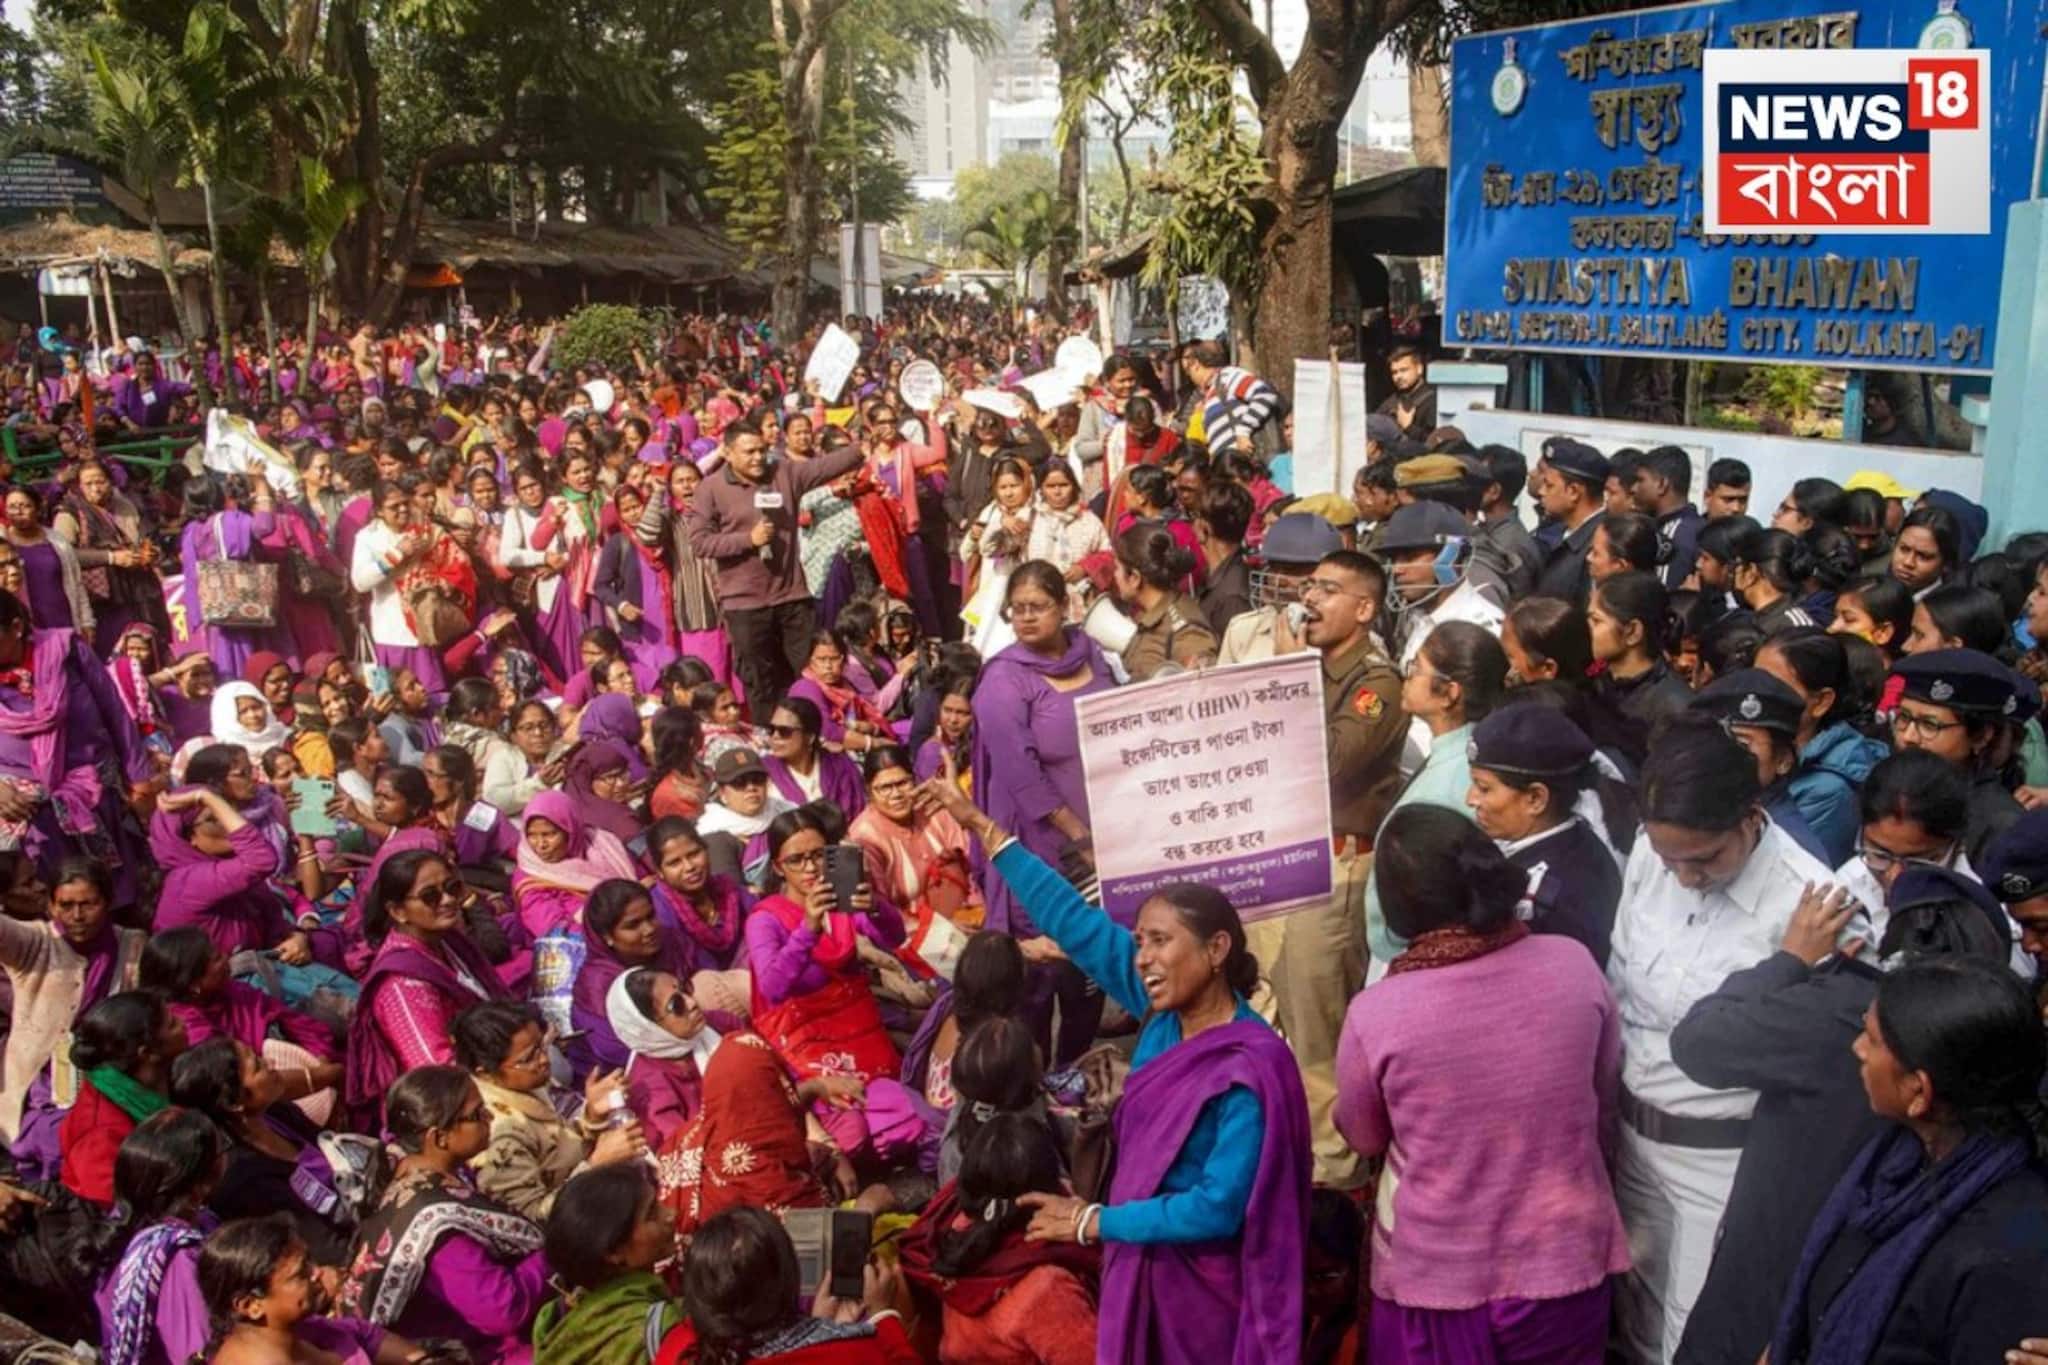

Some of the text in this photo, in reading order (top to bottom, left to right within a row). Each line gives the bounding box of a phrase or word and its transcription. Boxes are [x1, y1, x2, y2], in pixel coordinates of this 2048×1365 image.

[1589, 83, 1684, 149] স্বাস্থ্য
[1503, 254, 1921, 311] SWASTHYA BHAWAN
[1742, 317, 1800, 351] CITY,
[1089, 680, 1311, 738] আরবান আশা (HHW) কর্মীদের
[1206, 727, 1249, 749] পাওনা
[1252, 719, 1285, 741] টাকা
[1143, 776, 1182, 797] ভাগে
[1184, 768, 1222, 790] ভাগে
[1169, 797, 1254, 826] ও বাকি রাখা
[1162, 829, 1266, 861] বন্ধ করতে হবে
